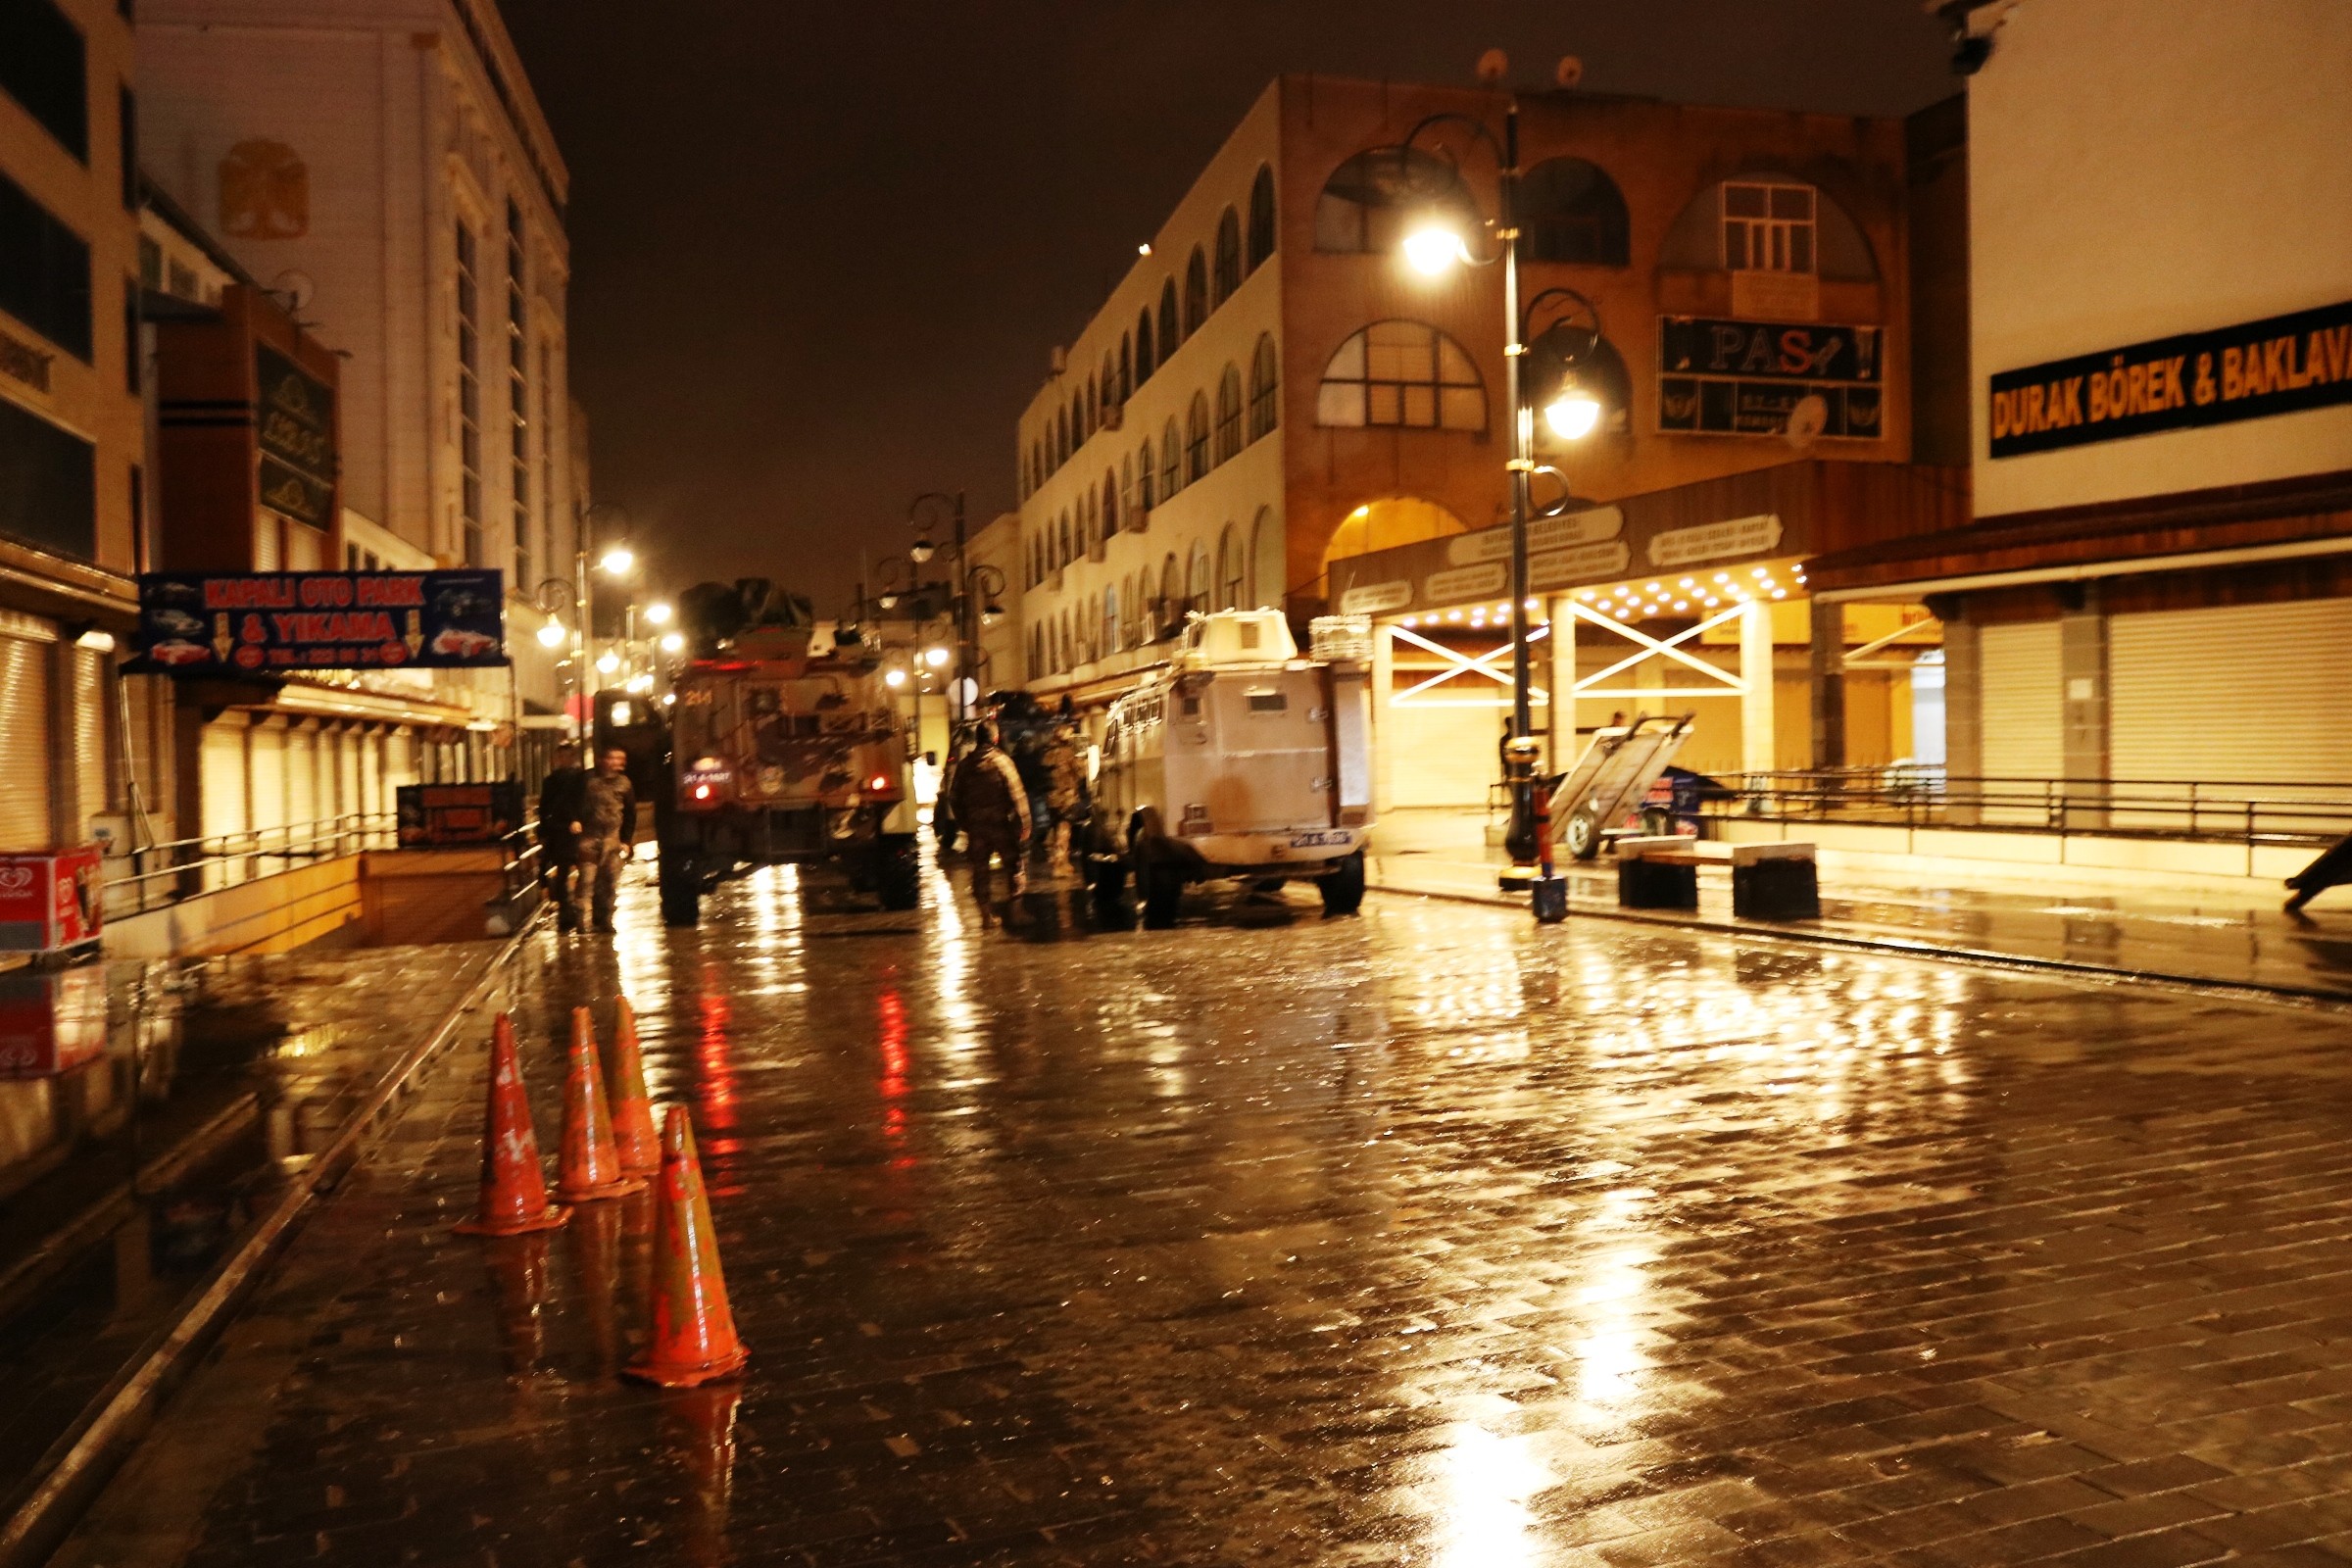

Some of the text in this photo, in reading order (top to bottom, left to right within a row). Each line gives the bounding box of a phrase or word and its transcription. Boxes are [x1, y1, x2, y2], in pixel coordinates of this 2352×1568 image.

[1992, 376, 2083, 439] DURAK
[2089, 355, 2186, 423] BÖREK
[2192, 353, 2217, 406] &
[204, 576, 426, 609] KAPALI OTO PARK
[241, 611, 398, 644] & YIKAMA
